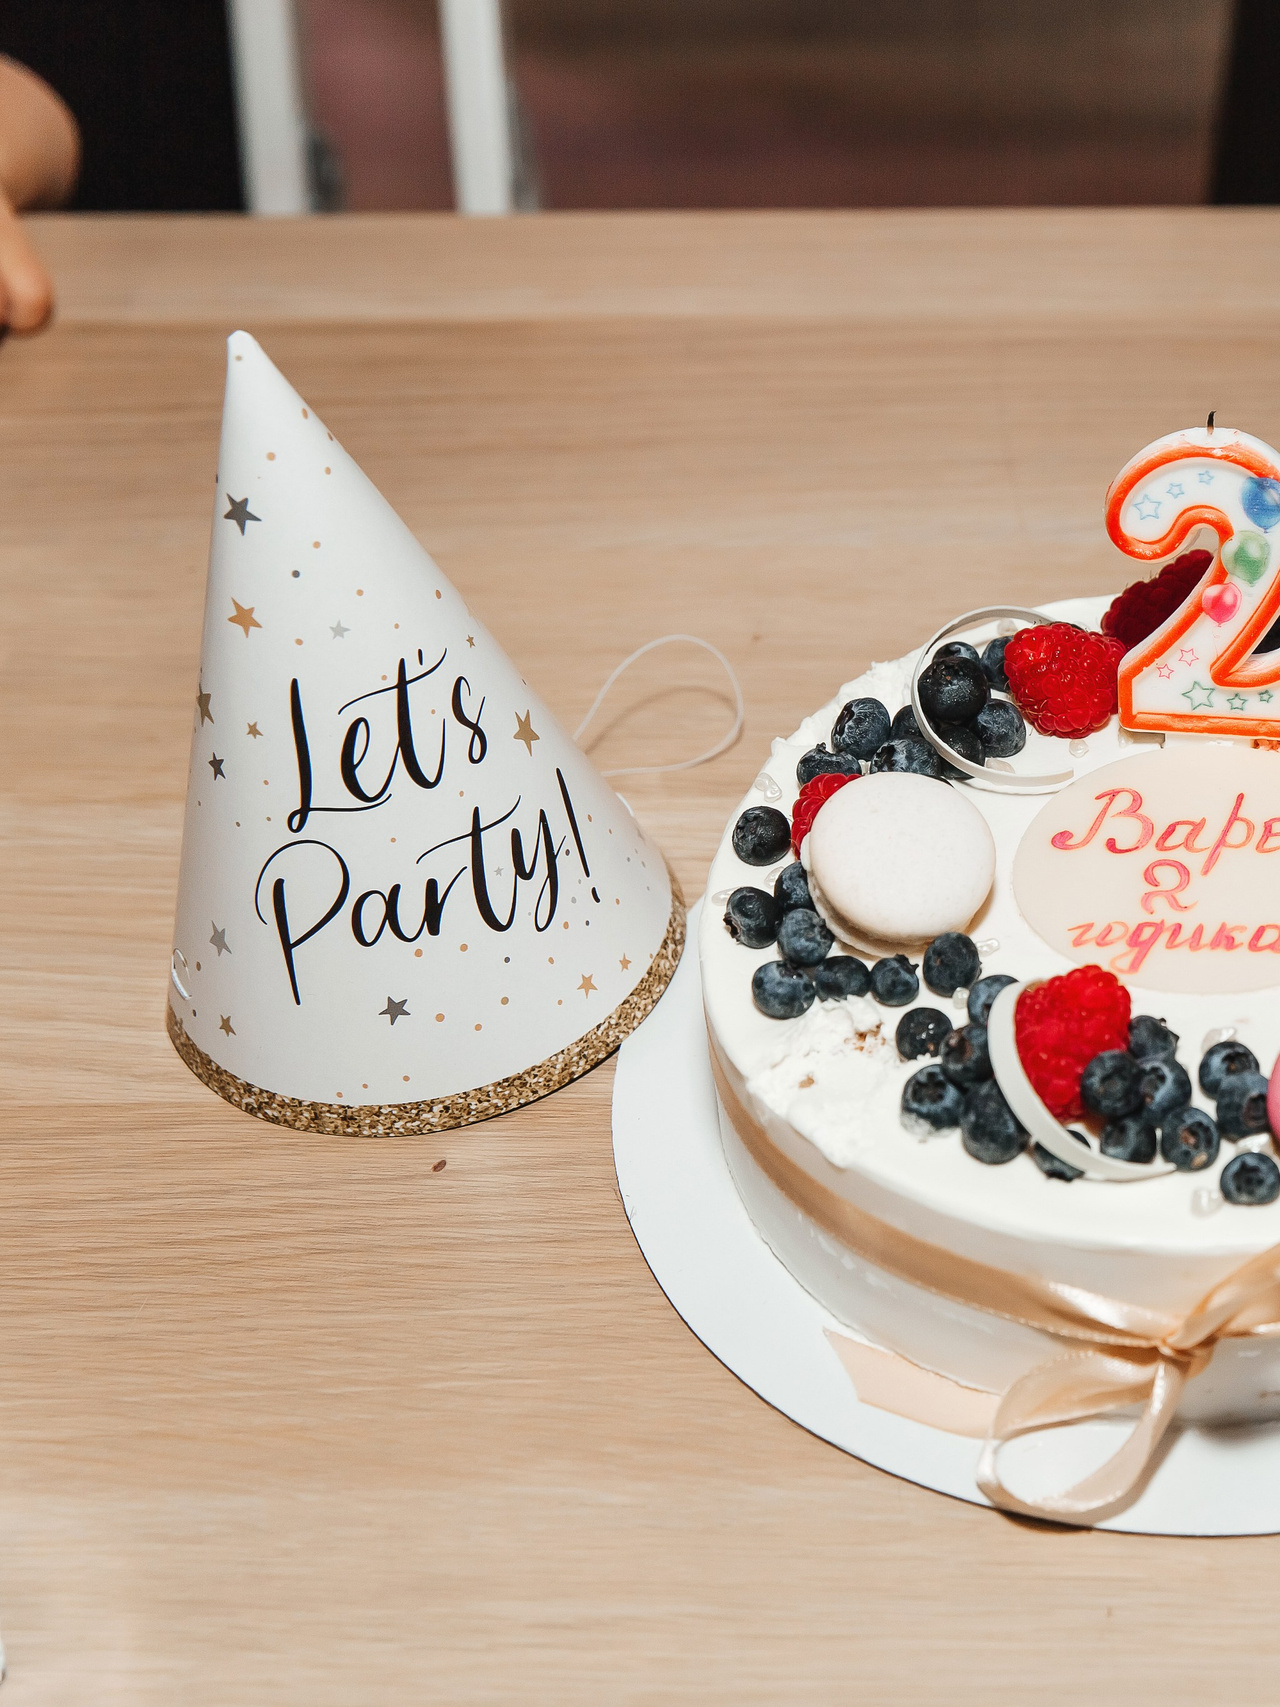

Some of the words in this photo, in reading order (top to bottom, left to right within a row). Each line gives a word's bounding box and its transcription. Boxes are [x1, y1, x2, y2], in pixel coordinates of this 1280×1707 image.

[286, 647, 487, 834] Let's
[254, 767, 601, 1006] Party!
[1140, 858, 1199, 915] 2
